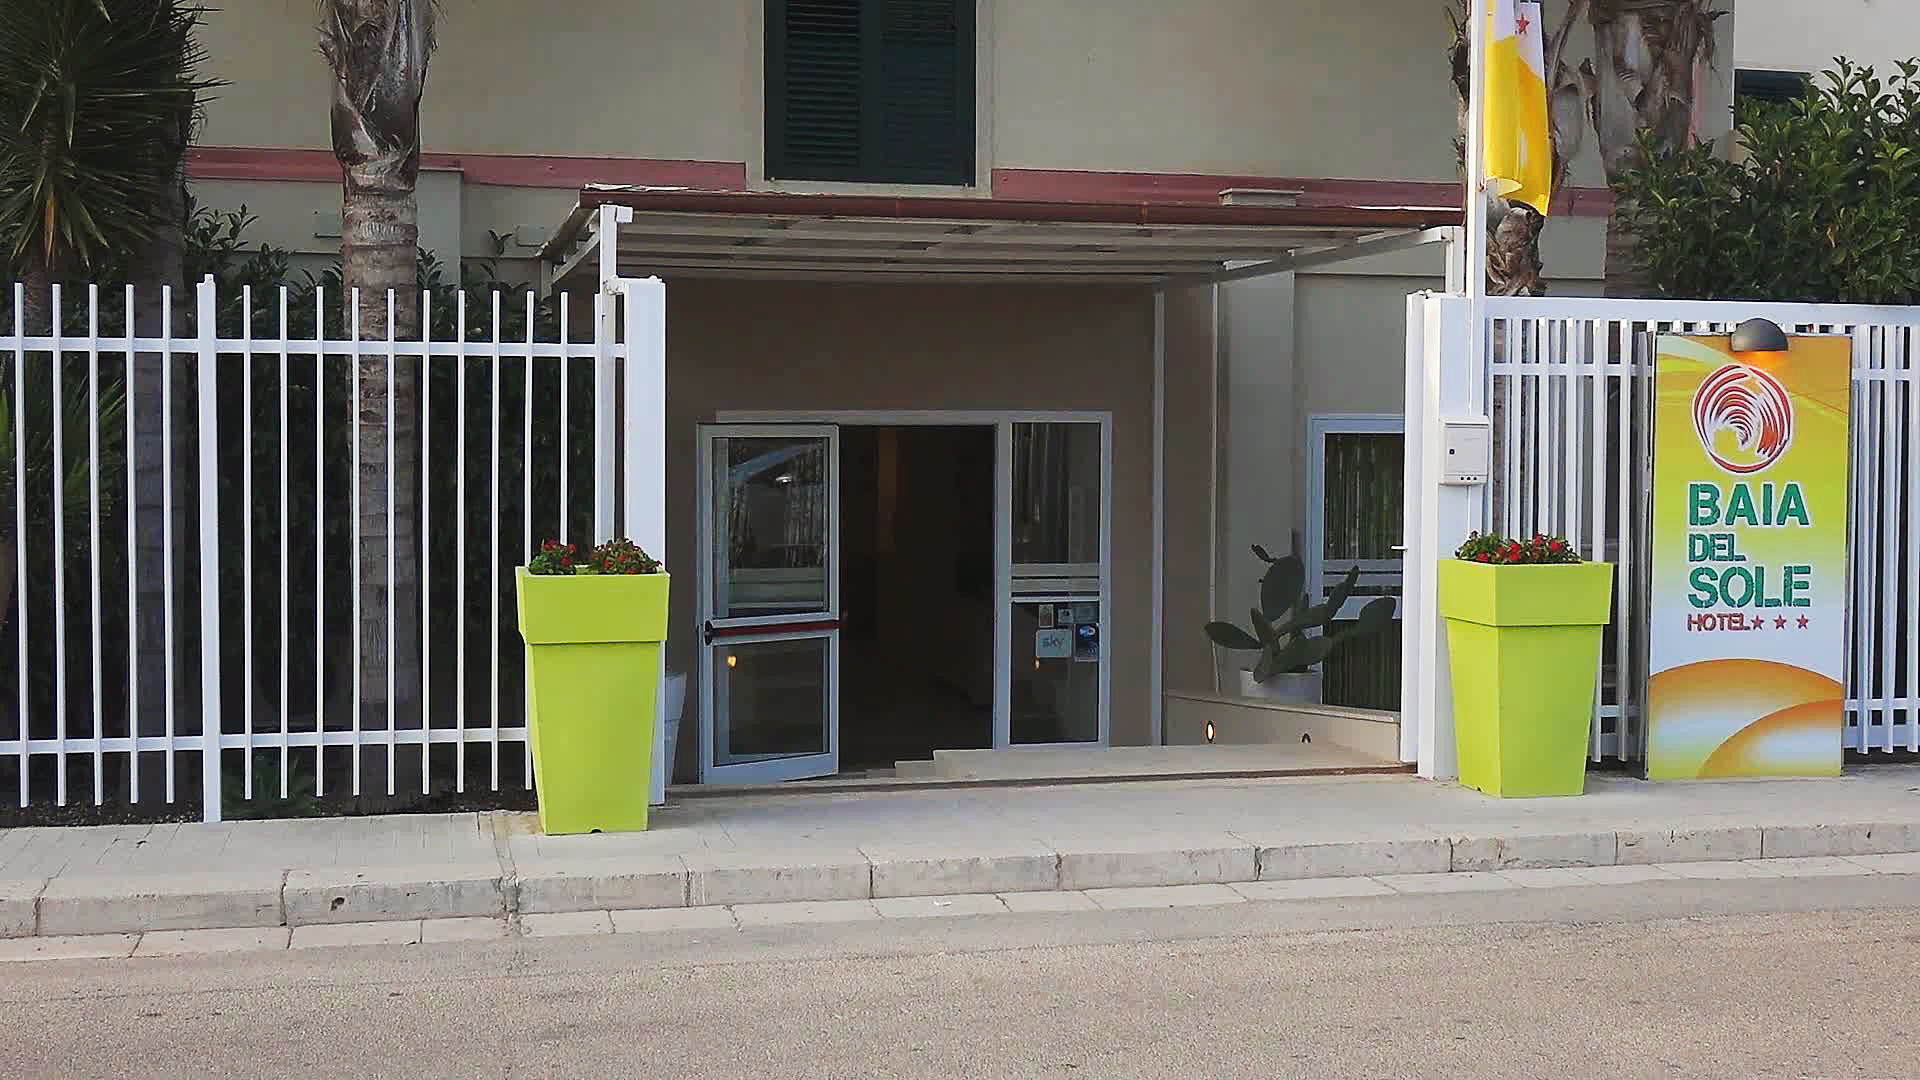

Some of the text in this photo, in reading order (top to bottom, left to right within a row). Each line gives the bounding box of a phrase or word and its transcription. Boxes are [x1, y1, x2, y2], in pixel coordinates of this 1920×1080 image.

[1689, 483, 1809, 526] BAIA
[1688, 533, 1746, 562] DEL
[1688, 566, 1811, 609] SOLE
[1687, 613, 1750, 631] HOTEL
